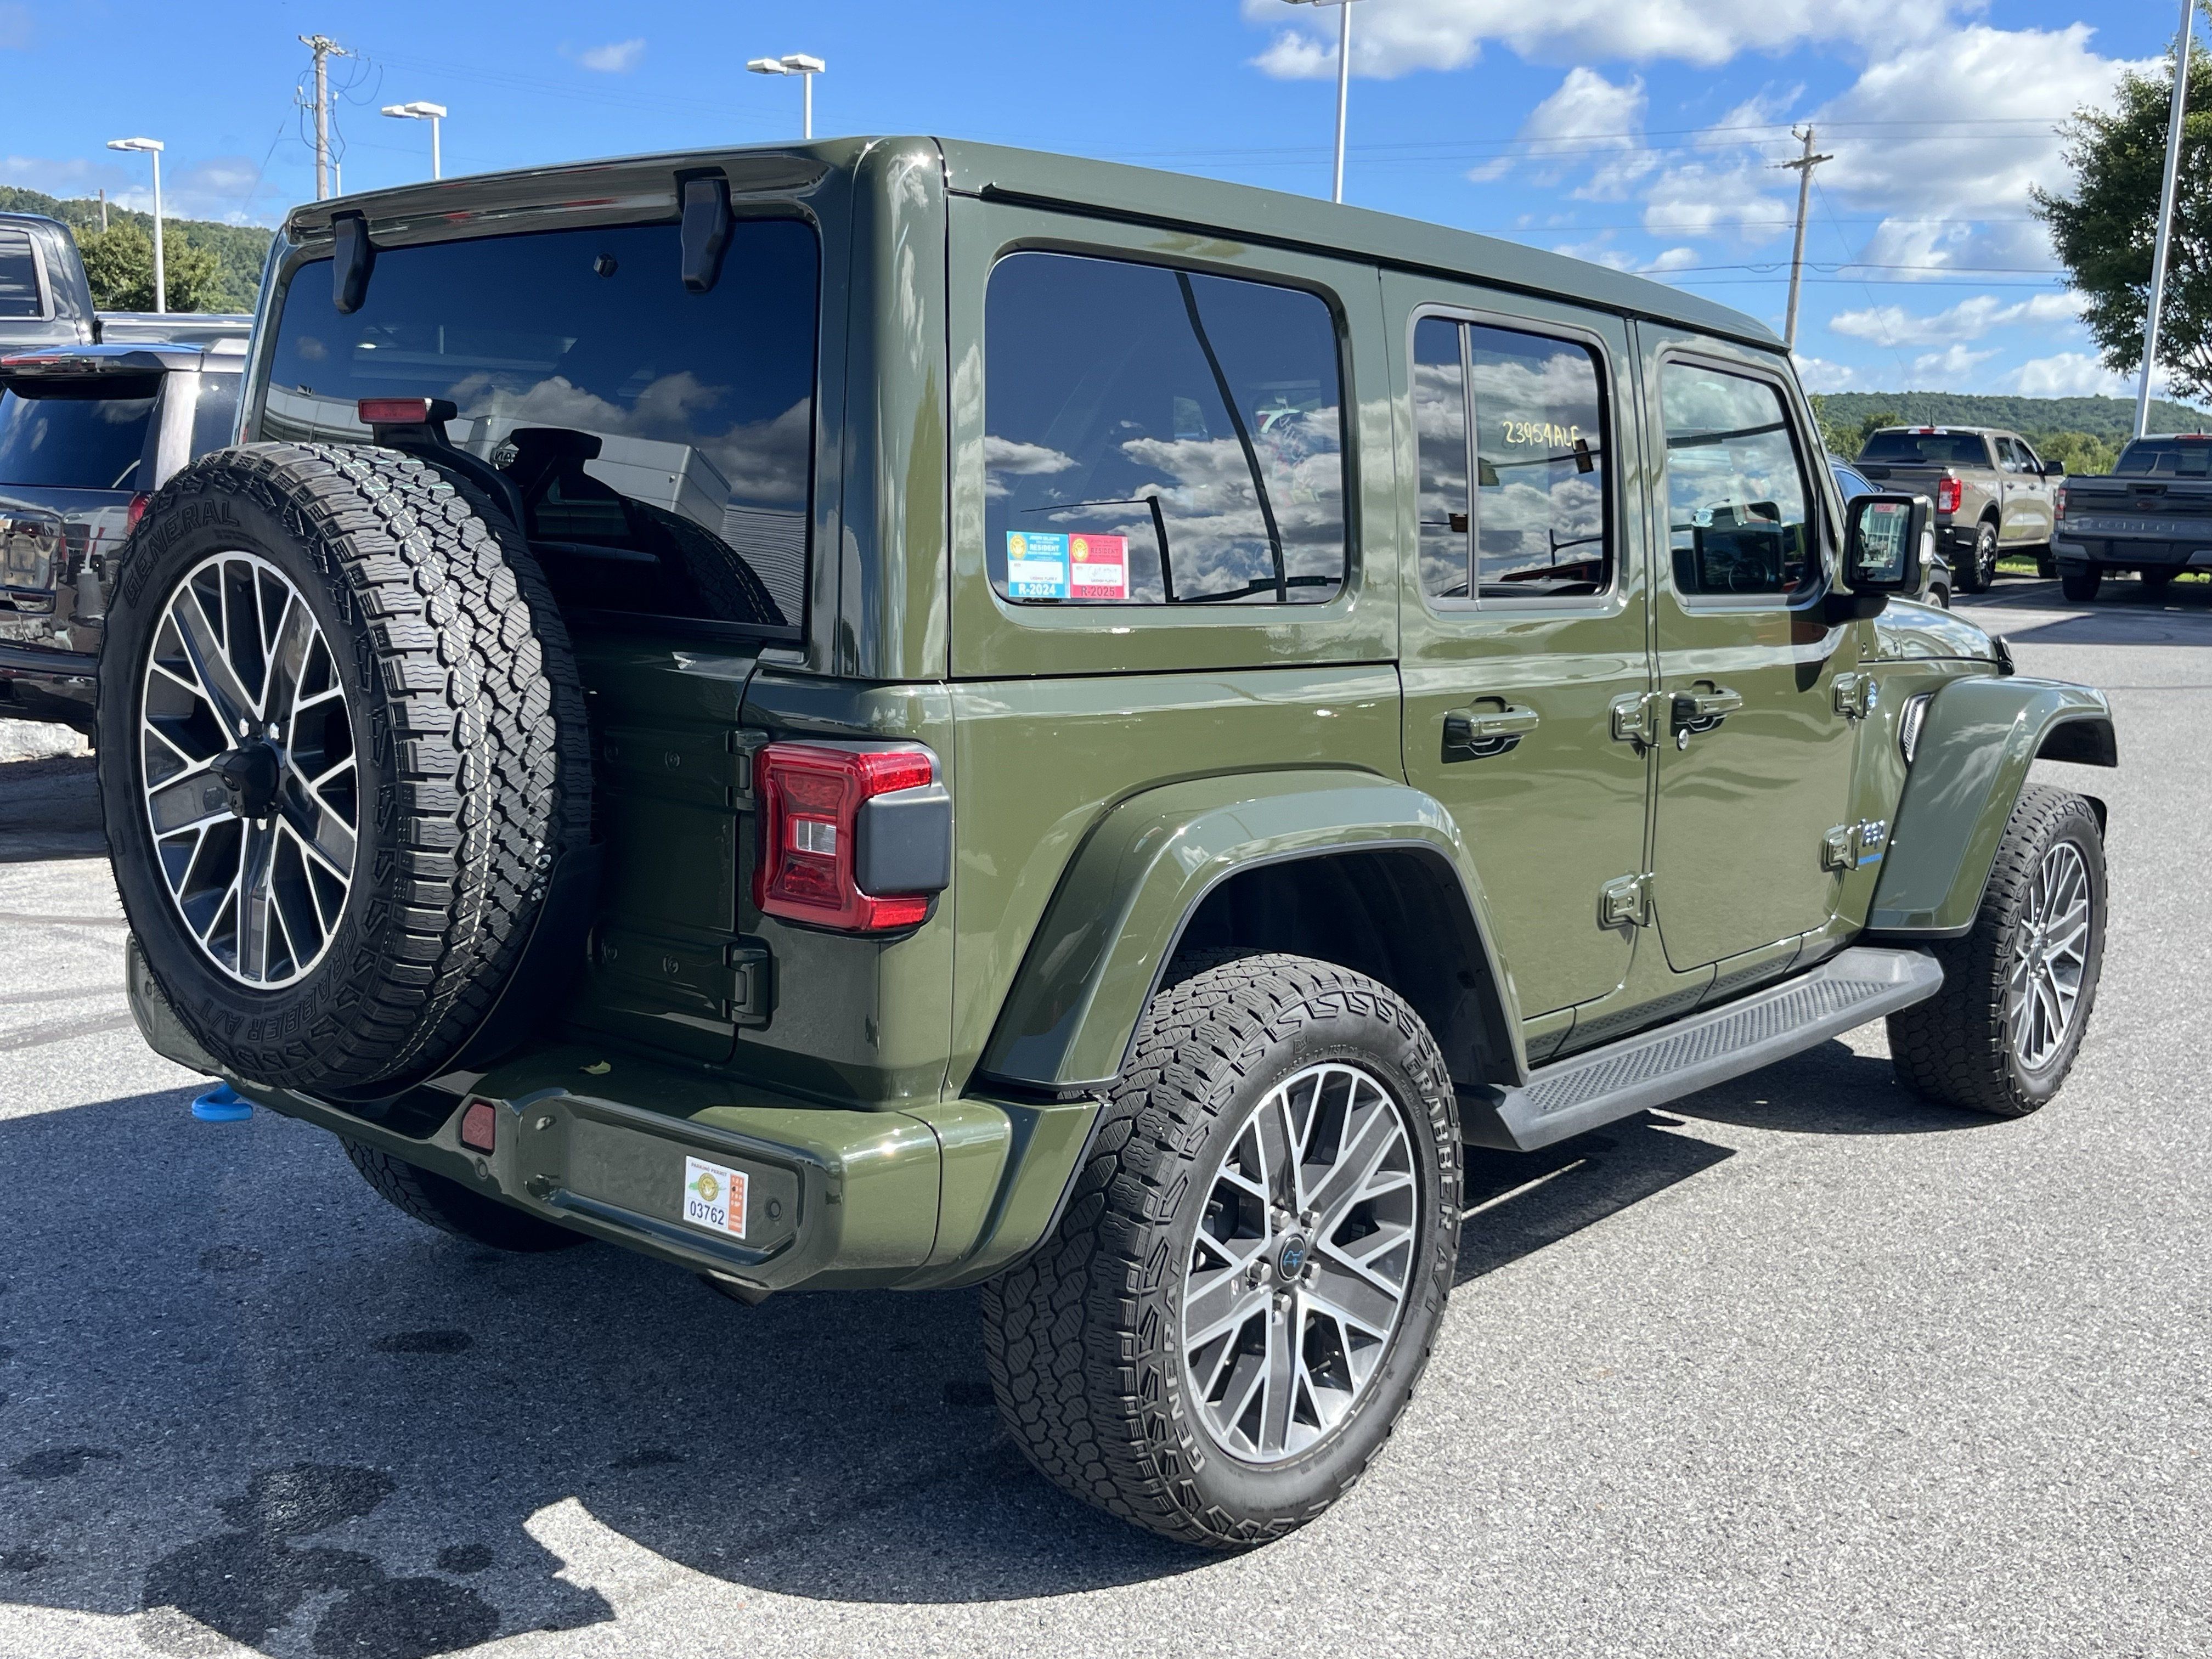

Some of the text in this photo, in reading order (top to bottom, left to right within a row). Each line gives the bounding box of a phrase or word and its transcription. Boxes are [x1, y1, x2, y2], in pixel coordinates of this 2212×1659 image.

[122, 499, 240, 609] GENERAL
[1029, 544, 1060, 552] RESIDENT
[1018, 583, 1056, 595] R-2024
[1081, 586, 1115, 597] R-2025
[247, 911, 357, 1042] GRABBER
[1401, 1050, 1454, 1232] GRABBER
[691, 1161, 727, 1177] PARKING PERMIT
[690, 1200, 725, 1226] 03762
[1163, 1256, 1205, 1474] GENERAL
